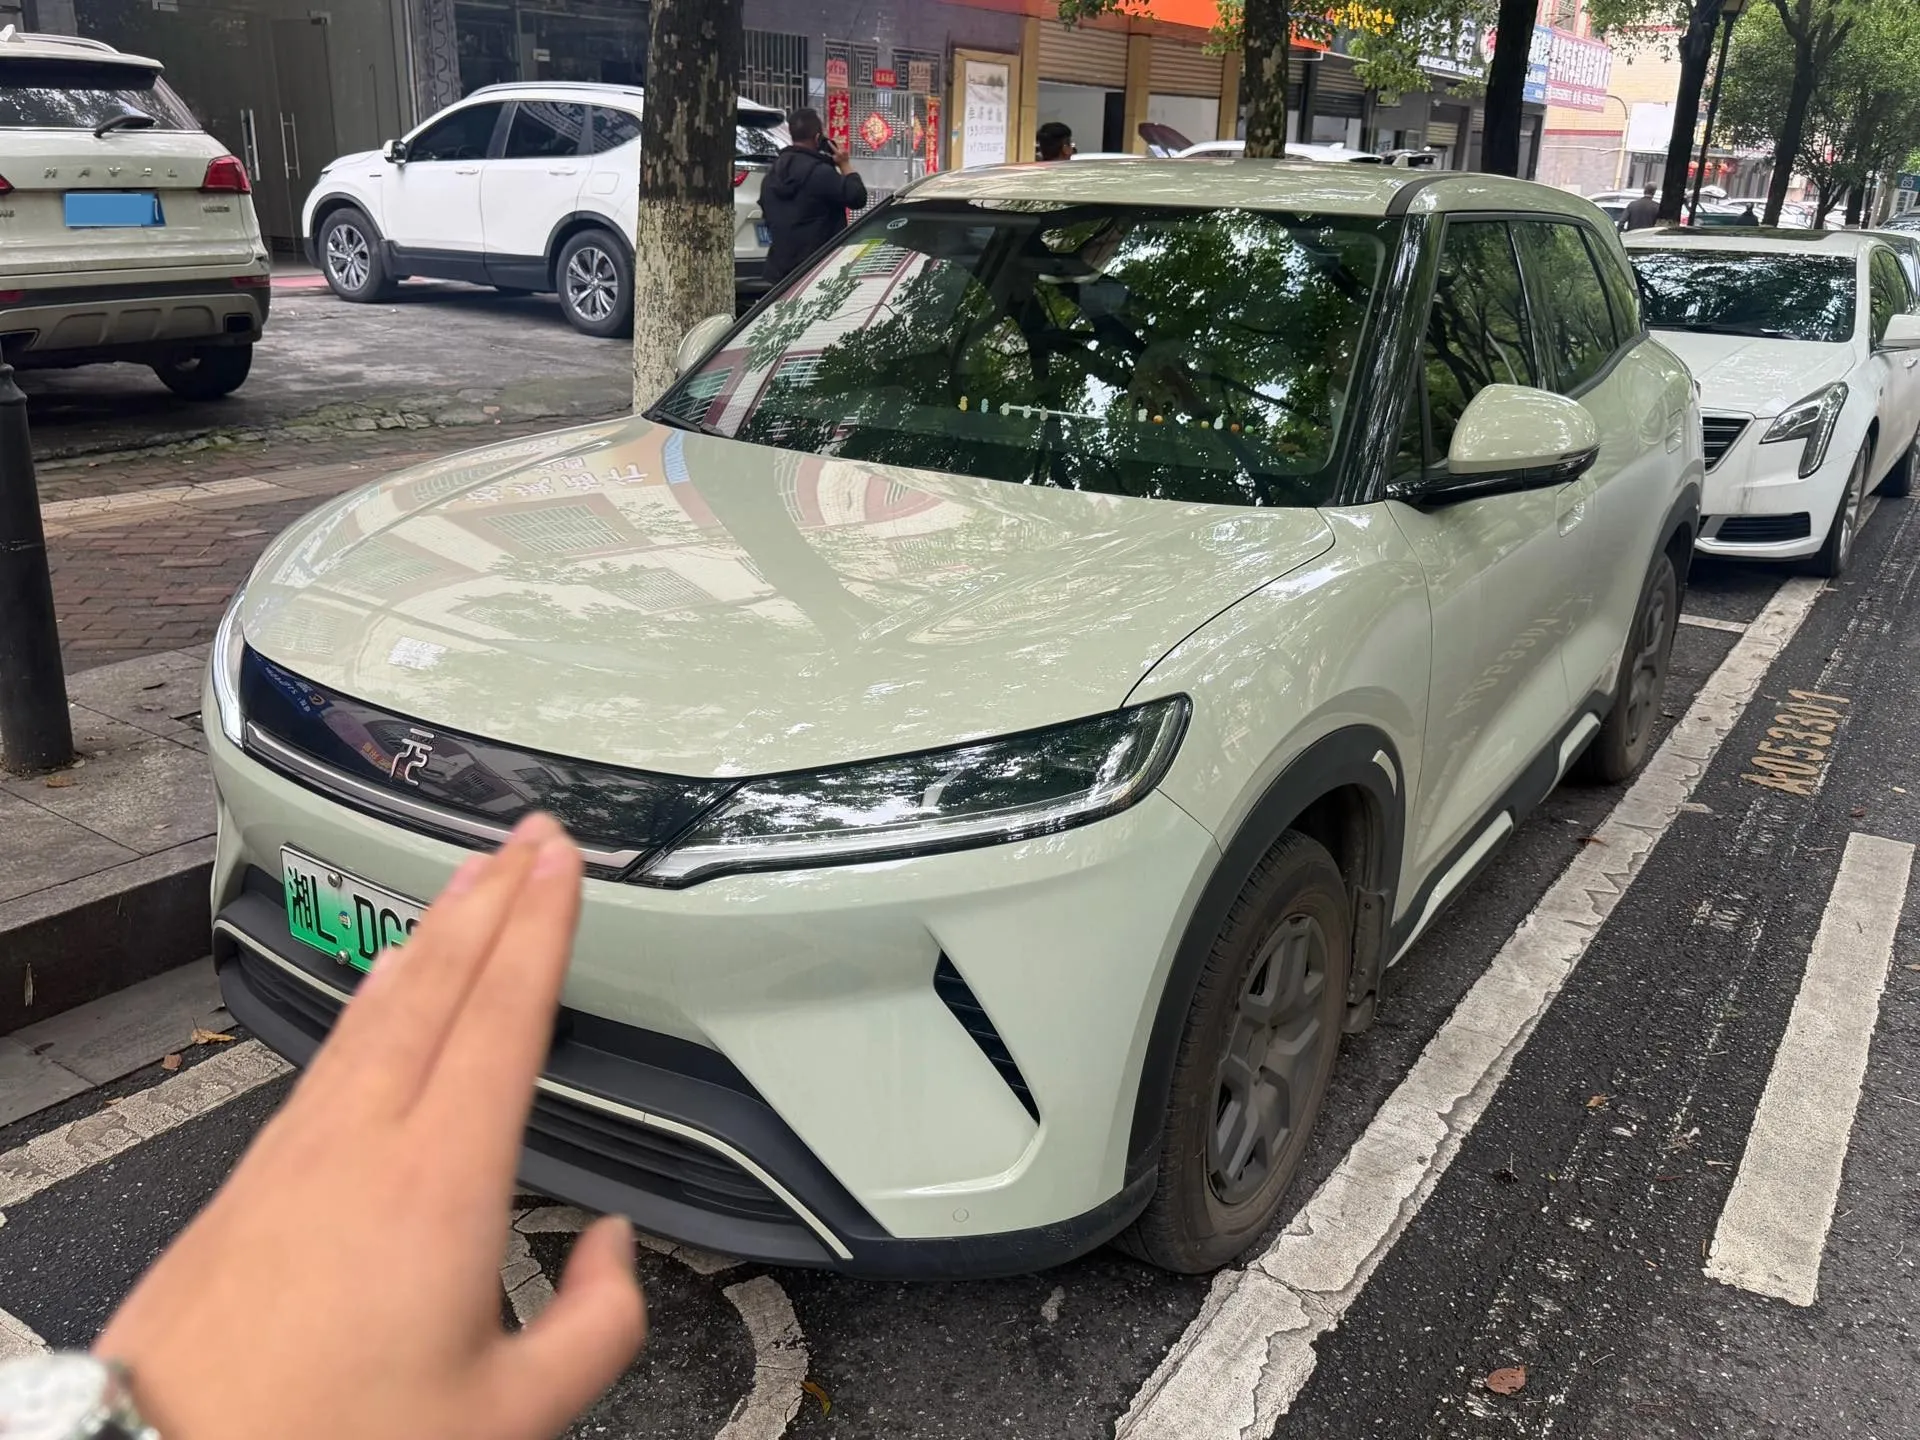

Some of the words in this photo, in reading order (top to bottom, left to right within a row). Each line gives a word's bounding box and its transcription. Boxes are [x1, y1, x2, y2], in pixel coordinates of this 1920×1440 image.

[43, 167, 178, 179] HAVAL
[1740, 689, 1850, 795] A053301
[353, 893, 420, 960] DG
